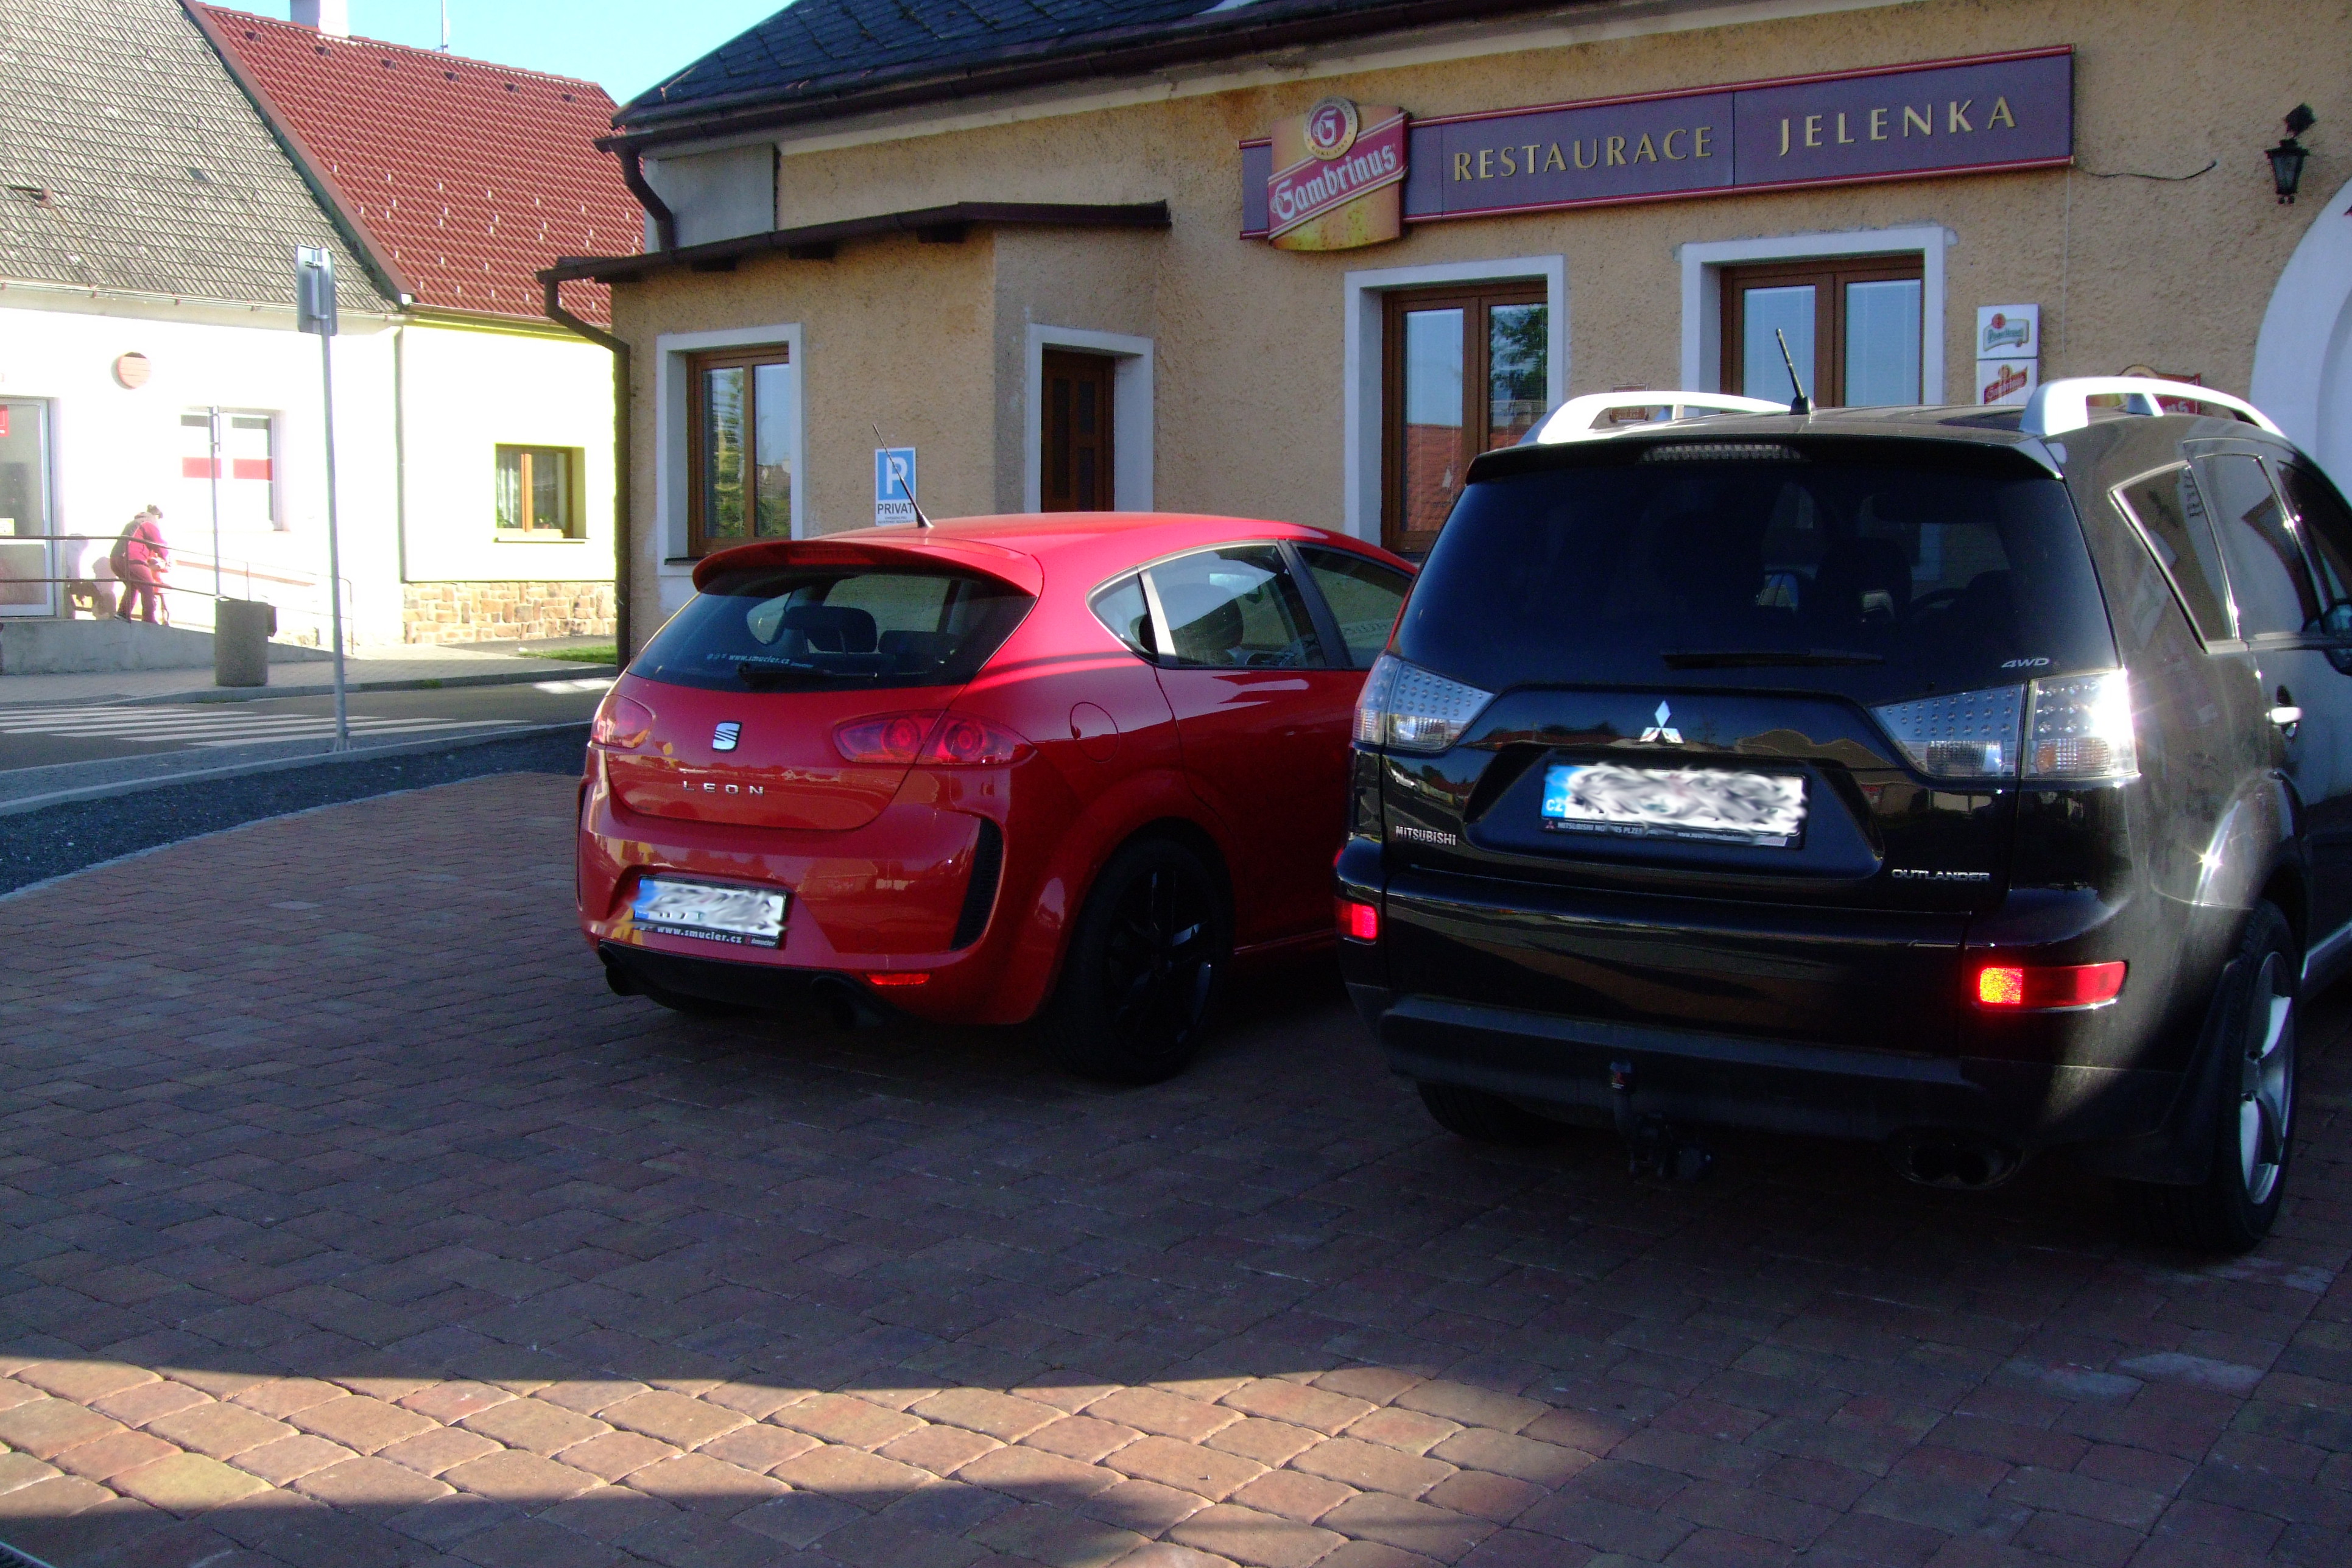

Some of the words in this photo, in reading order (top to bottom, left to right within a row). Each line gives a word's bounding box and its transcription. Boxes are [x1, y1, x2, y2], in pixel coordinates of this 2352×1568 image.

[1454, 126, 1713, 182] RESTAURACE
[1779, 96, 2016, 156] JELENKA
[1270, 144, 1396, 221] Gambrinus
[886, 457, 907, 494] P
[878, 502, 912, 515] PRIVAT
[2001, 658, 2049, 668] 4WD
[683, 780, 764, 796] LEON
[1546, 799, 1563, 812] CZ
[1395, 826, 1456, 846] MITSUBISHI
[1892, 869, 1990, 881] OUTLANDER
[657, 926, 742, 944] www.smucler.cz
